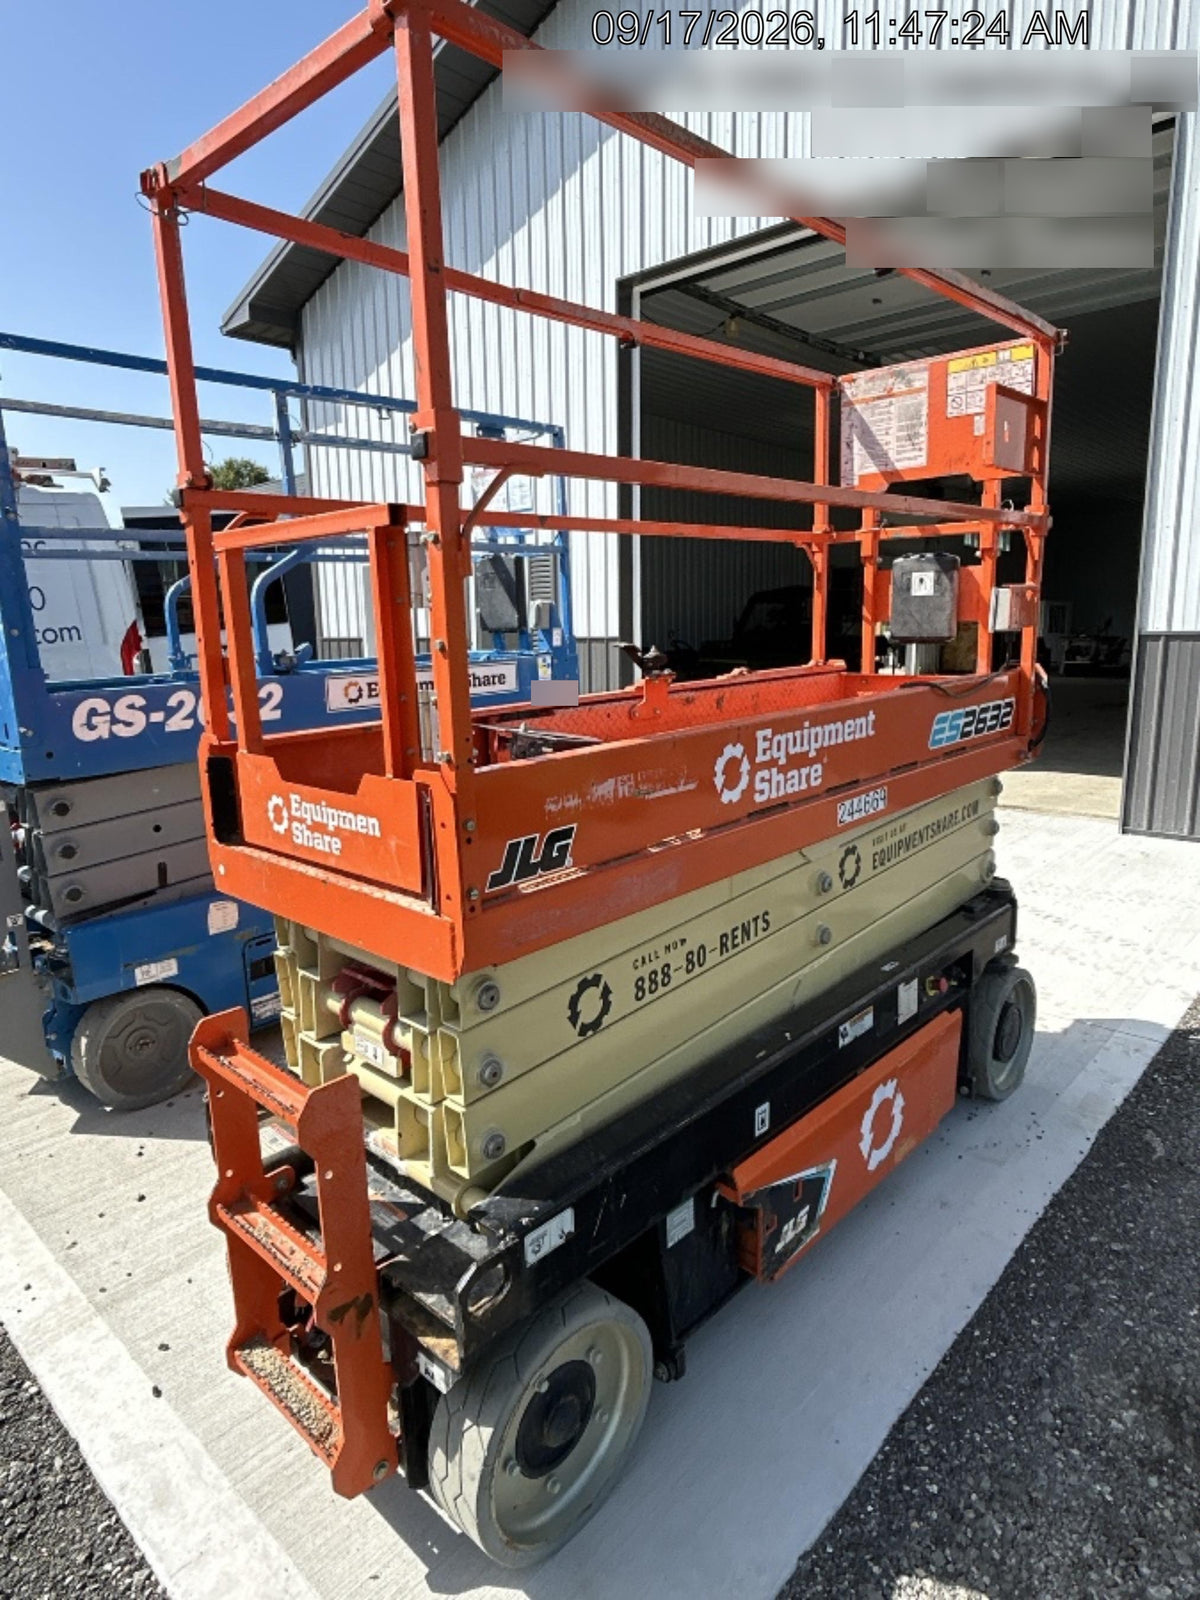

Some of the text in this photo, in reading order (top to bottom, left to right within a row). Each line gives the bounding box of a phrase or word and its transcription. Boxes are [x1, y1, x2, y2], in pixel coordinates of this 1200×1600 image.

[72, 682, 283, 742] GS-22
[755, 709, 875, 765] Equipment
[928, 697, 1016, 750] ES2632
[754, 762, 823, 803] Share
[289, 793, 381, 838] Equipmen
[291, 821, 342, 856] Share
[872, 799, 980, 870] EQUIPMENTSHARE.COM
[485, 823, 578, 893] JLG
[633, 938, 687, 970] CALL NOW
[634, 910, 771, 1001] 888-80-RENTS
[775, 1204, 810, 1254] JLG
